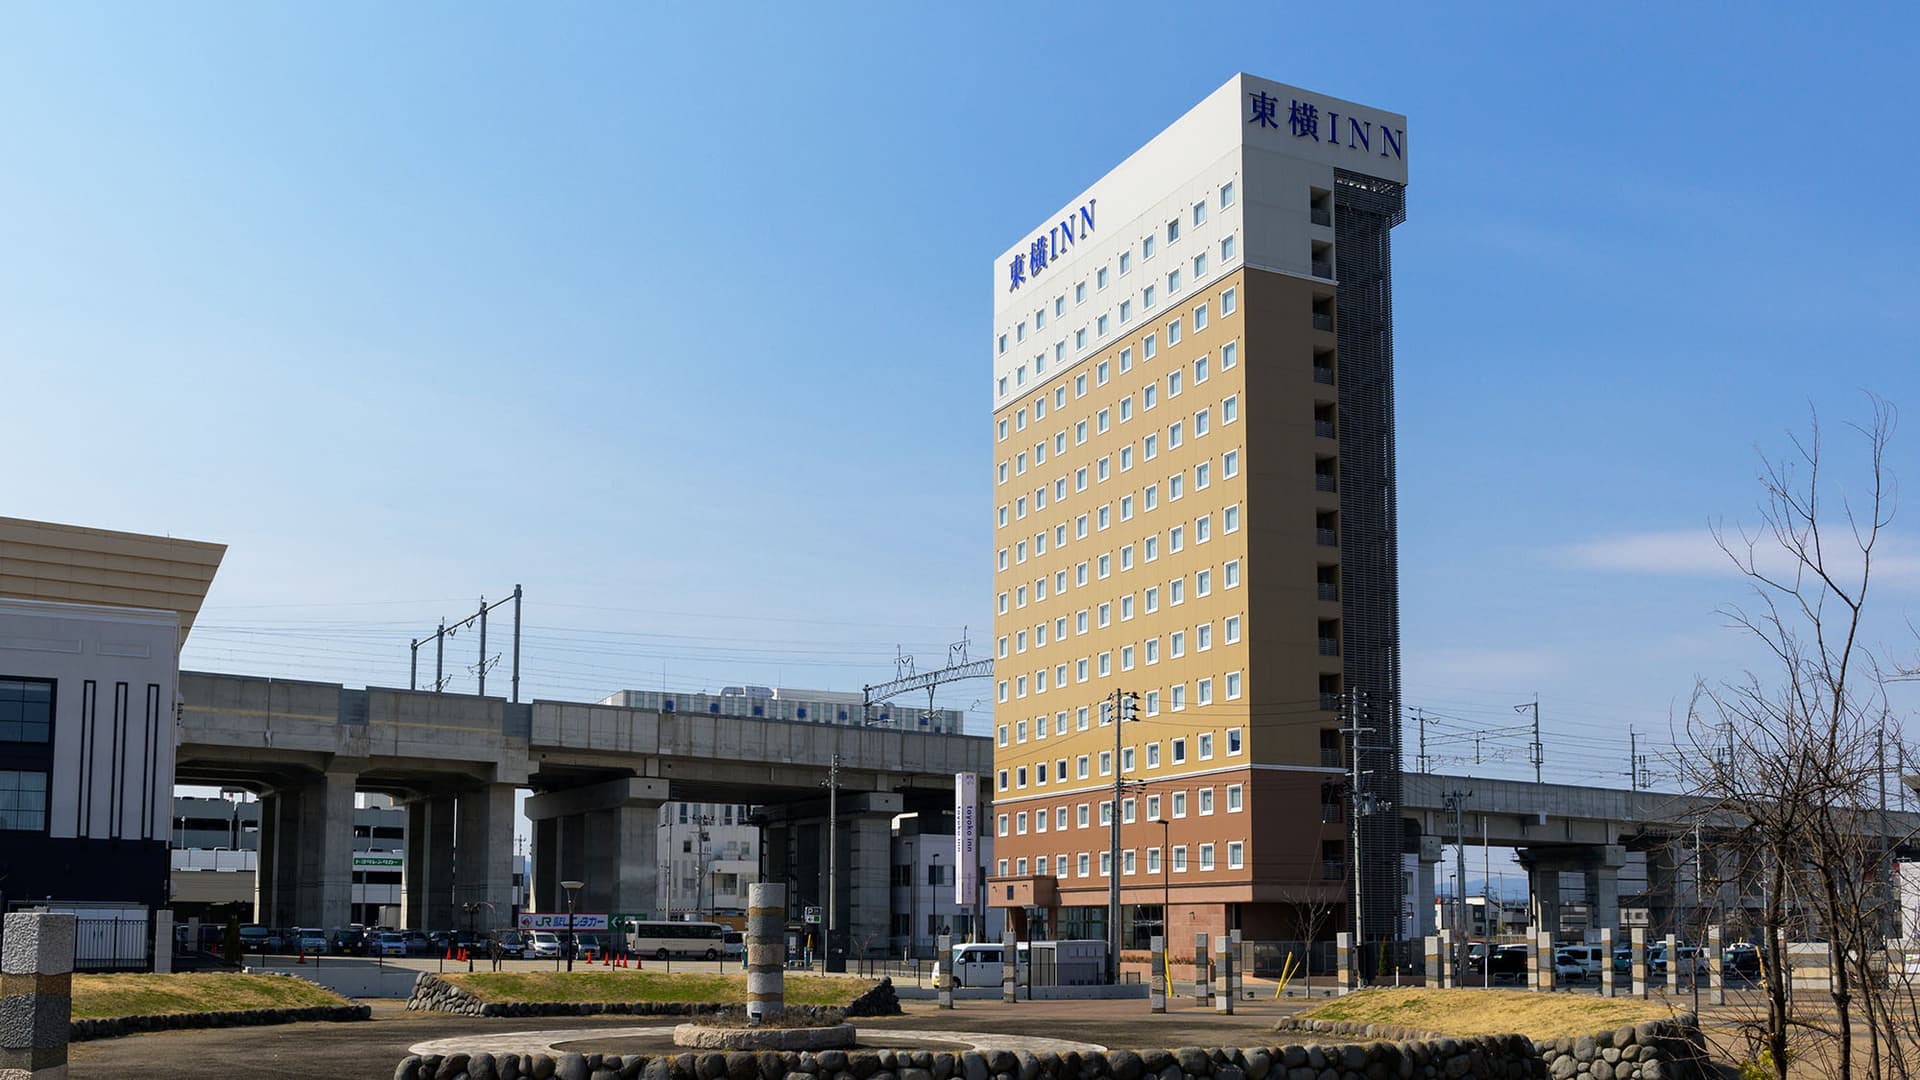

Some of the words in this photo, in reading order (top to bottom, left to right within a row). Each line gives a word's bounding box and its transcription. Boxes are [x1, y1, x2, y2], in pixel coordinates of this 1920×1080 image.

[1248, 91, 1403, 160] 東横INN
[1009, 199, 1096, 293] 東横INN
[966, 806, 974, 836] toyoko
